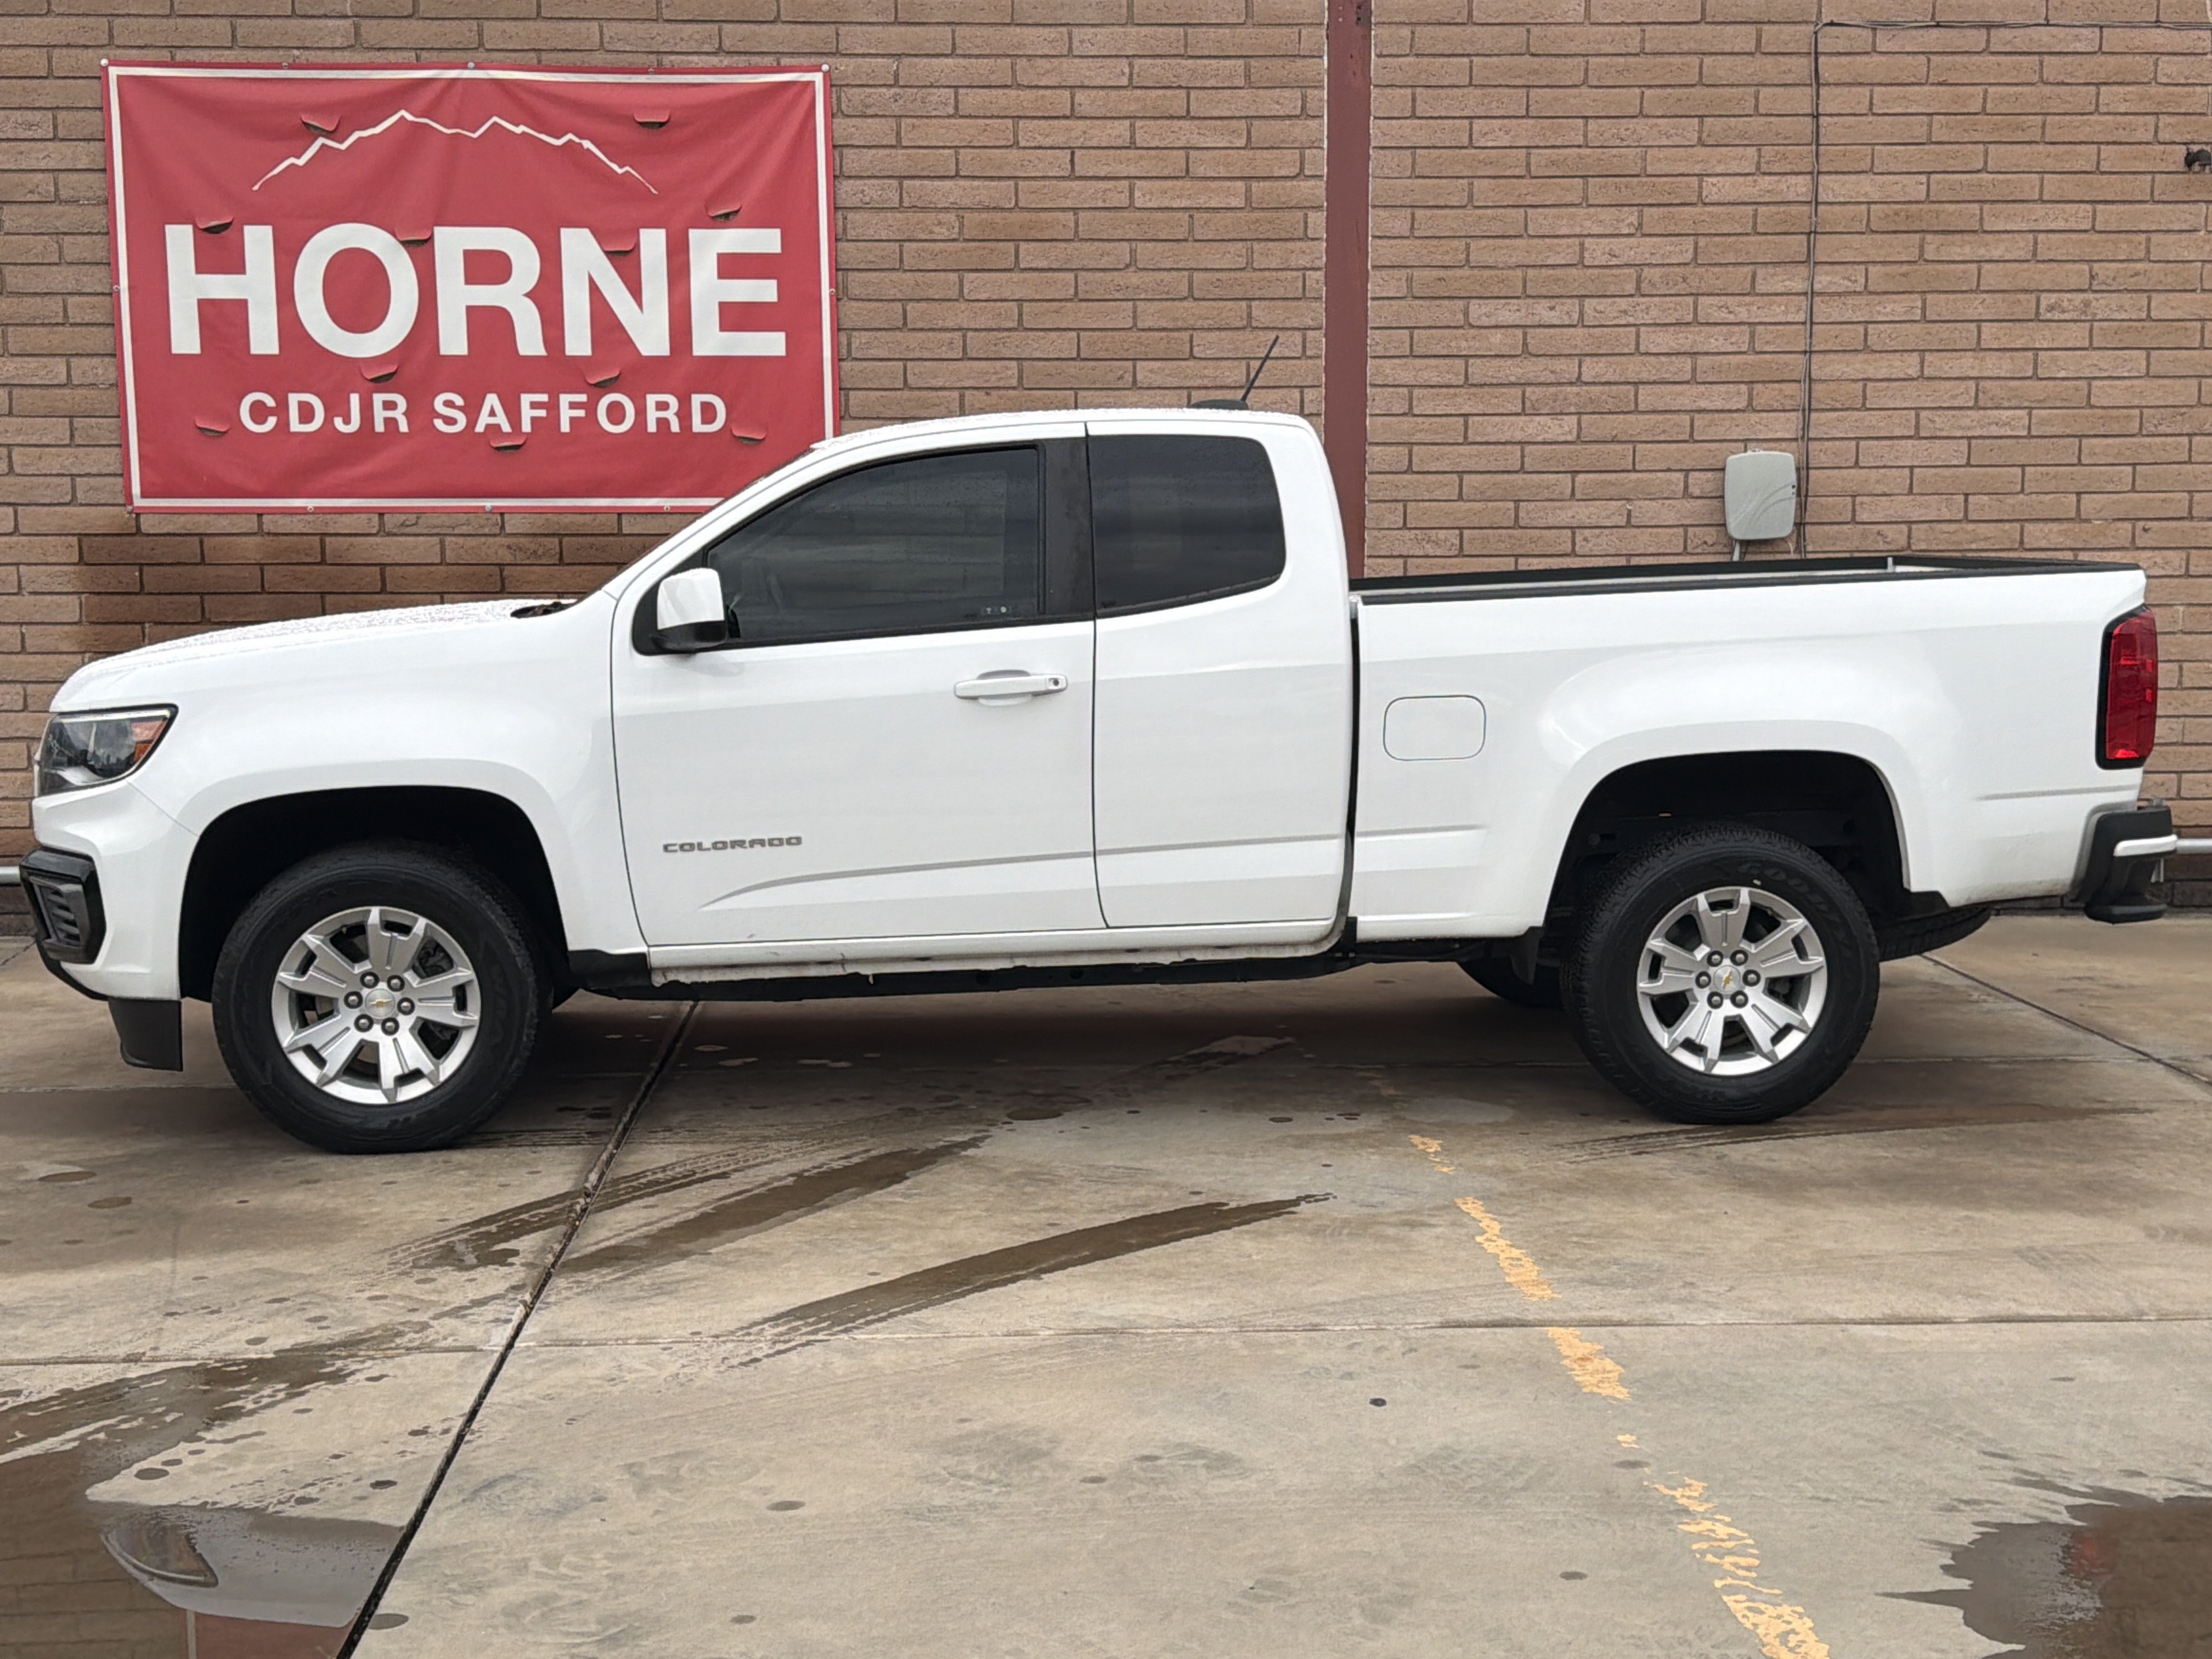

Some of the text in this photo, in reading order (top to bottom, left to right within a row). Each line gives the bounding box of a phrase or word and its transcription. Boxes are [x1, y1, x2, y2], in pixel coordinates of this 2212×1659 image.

[165, 223, 787, 358] HORNE
[239, 392, 727, 433] CDJR SAFFORD
[662, 836, 802, 853] COLORADO
